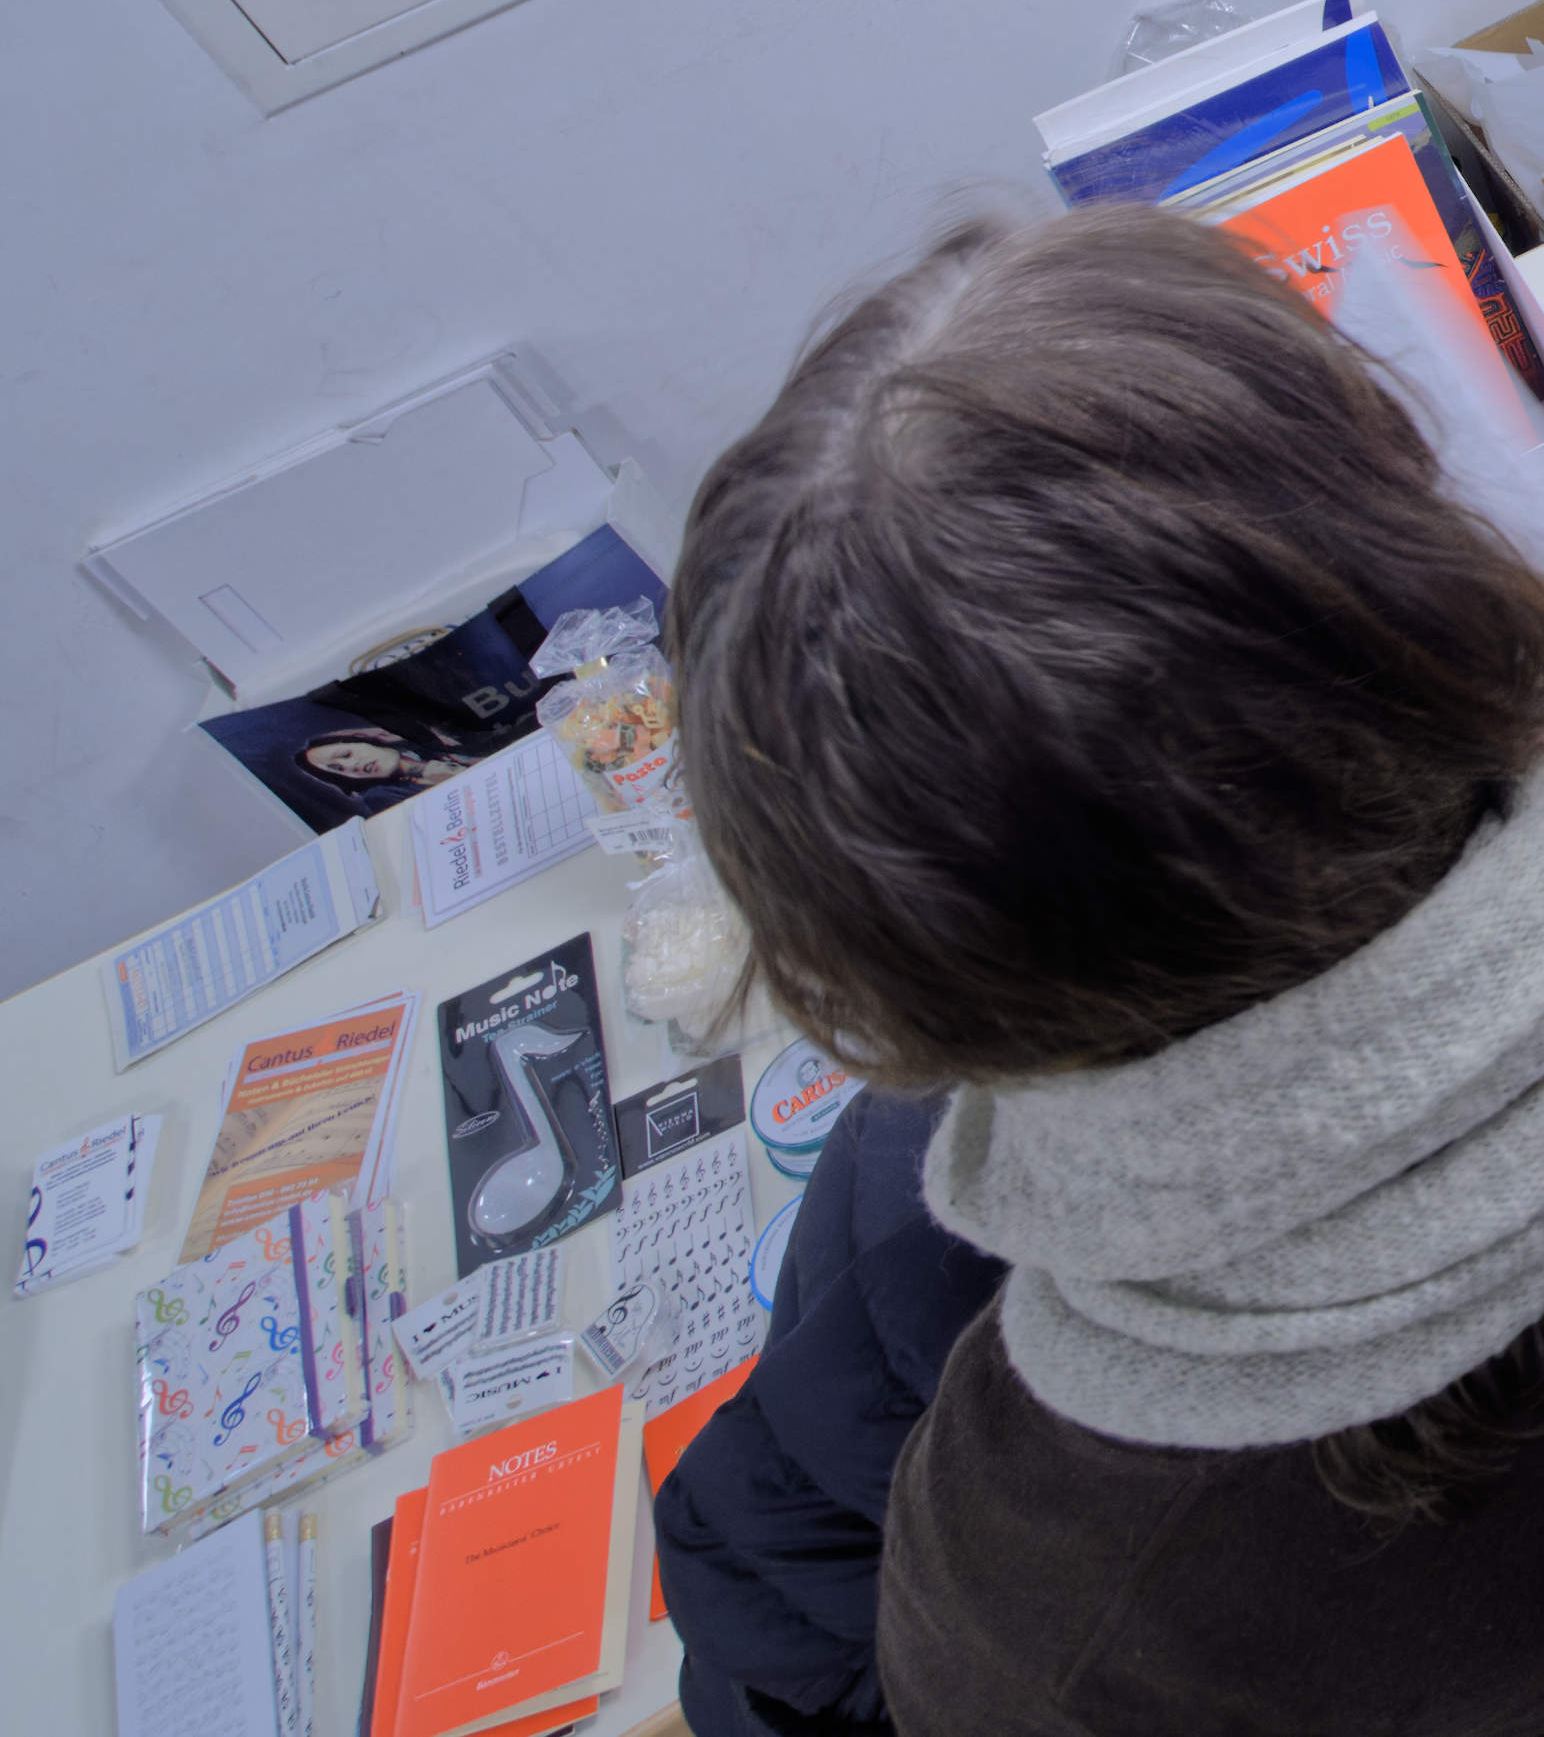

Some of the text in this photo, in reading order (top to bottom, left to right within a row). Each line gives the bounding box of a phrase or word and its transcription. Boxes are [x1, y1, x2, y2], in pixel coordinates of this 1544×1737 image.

[444, 788, 470, 891] Riedel Berlin
[455, 1004, 520, 1044] Music
[508, 1001, 558, 1029] Strainer
[247, 1046, 314, 1073] Cantus
[335, 1020, 397, 1050] Riedel
[772, 1069, 846, 1124] CARUS
[440, 1294, 480, 1323] MUS
[488, 1440, 557, 1482] NOTES
[465, 1549, 481, 1563] The
